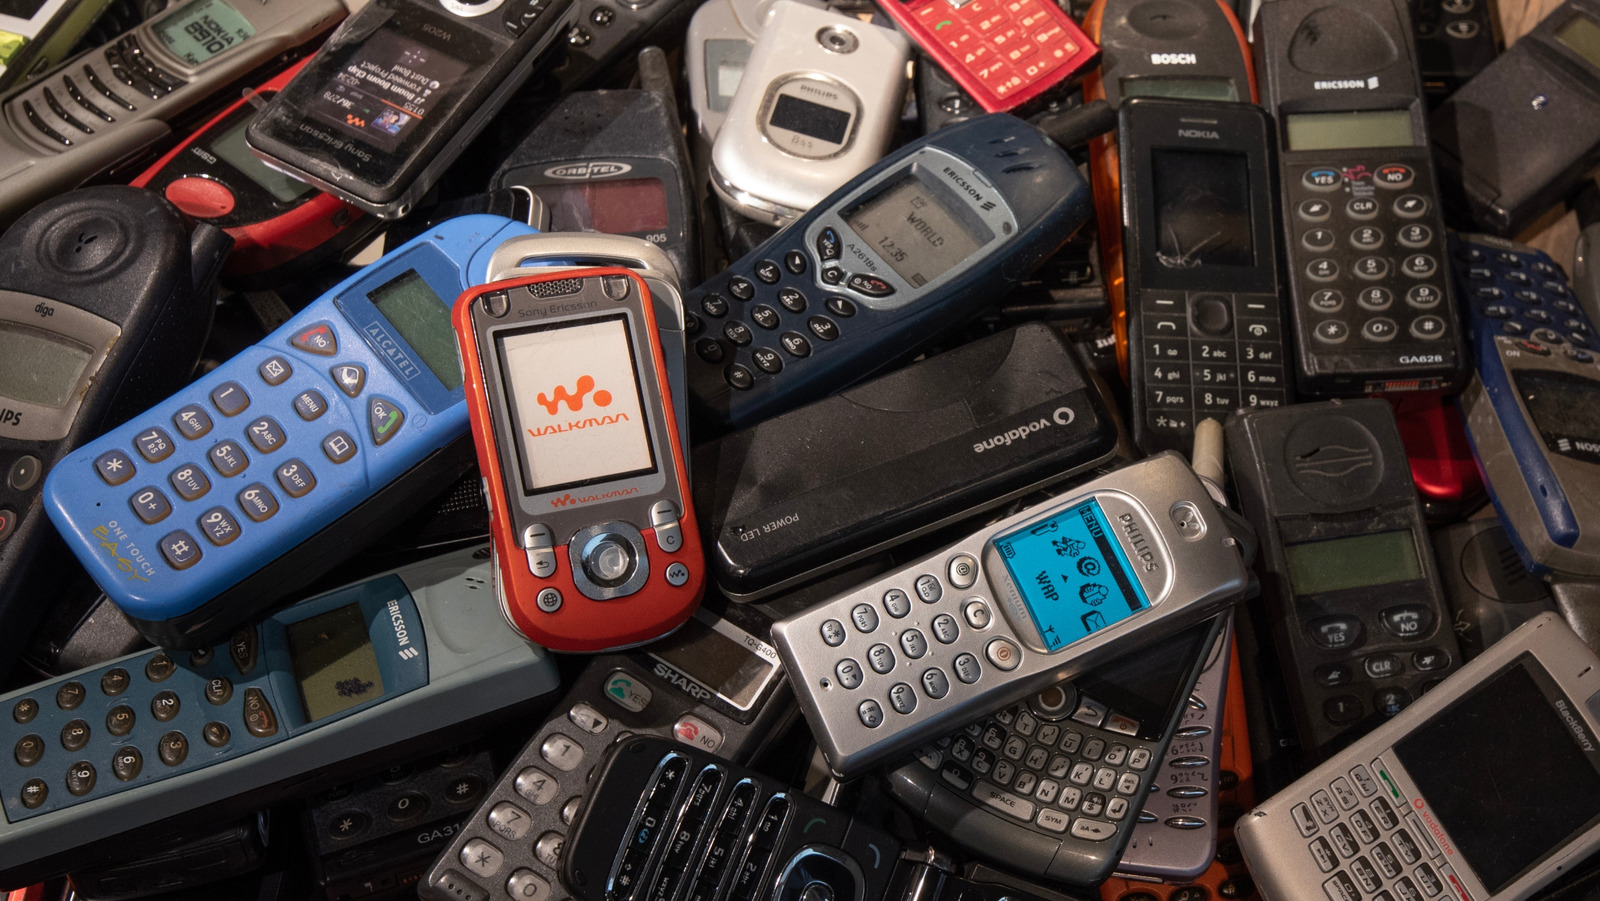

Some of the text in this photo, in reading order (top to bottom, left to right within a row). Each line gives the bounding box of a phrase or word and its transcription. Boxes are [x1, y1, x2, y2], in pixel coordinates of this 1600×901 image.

[202, 14, 234, 45] NOKIA
[184, 21, 225, 54] 8910
[1151, 53, 1196, 65] BOSCH
[348, 65, 366, 80] Clap
[361, 60, 388, 78] Project
[366, 73, 392, 92] Boom
[410, 72, 429, 86] Dust
[1314, 80, 1364, 90] ERICSSON
[390, 82, 414, 101] Boom
[801, 84, 838, 100] PHILIPS
[1178, 128, 1220, 140] NOKIA
[300, 124, 372, 162] Sony Ericsson
[191, 146, 216, 165] GSM
[555, 164, 619, 176] ORBITEL
[943, 166, 984, 202] ERICSSON
[1314, 176, 1334, 184] YES
[1388, 173, 1402, 182] NO
[1354, 202, 1373, 210] CLR
[906, 211, 944, 248] WORLD
[1362, 230, 1372, 238] 2
[1410, 227, 1420, 236] 3
[646, 234, 667, 244] 905
[877, 235, 909, 264] 12:35
[846, 243, 878, 273] A2618s
[1367, 259, 1376, 268] 5
[1414, 258, 1424, 266] 6
[1318, 261, 1328, 270] 4
[827, 269, 838, 280] C
[862, 280, 872, 290] NO
[1323, 292, 1332, 300] 7
[1371, 290, 1381, 299] 8
[1419, 288, 1429, 296] 9
[518, 300, 598, 318] Sony Ericsson
[314, 335, 328, 348] NO
[369, 326, 414, 376] ALCATEL
[1202, 346, 1227, 358] 2 abc
[1246, 348, 1272, 360] 3 def
[1400, 355, 1443, 364] GA628
[1154, 367, 1162, 378] 4
[1204, 369, 1211, 381] 5
[1248, 370, 1276, 384] 6 mno
[220, 387, 234, 398] 1
[1154, 391, 1184, 404] 7 pqrs
[1204, 393, 1229, 405] 8 tuv
[300, 394, 319, 412] MENU
[1250, 394, 1258, 406] 9
[374, 406, 386, 420] OK
[181, 410, 202, 432] 4 GHI
[528, 412, 630, 438] WALKMAN
[142, 431, 167, 450] 7 PQ
[252, 422, 276, 446] 2 ABC
[973, 418, 1051, 454] vodafone
[146, 443, 158, 454] RS
[216, 445, 238, 468] 5 JKL
[177, 469, 200, 492] 8 TUV
[283, 464, 306, 488] 3 DEF
[244, 488, 268, 514] 6 MNO
[577, 487, 639, 504] WALKMAN
[206, 512, 233, 534] 9 WX
[740, 512, 799, 544] POWER LED
[1080, 506, 1104, 538] MENU
[212, 524, 224, 538] YZ
[666, 535, 676, 546] C
[1118, 512, 1159, 574] PHILIPS
[92, 524, 150, 584] EASY
[108, 520, 156, 576] ONE TOUCH
[1034, 570, 1060, 602] WAP
[888, 593, 900, 602] 4
[857, 607, 868, 616] 7
[973, 608, 984, 618] C
[386, 600, 410, 647] ERICSSON
[938, 618, 948, 628] 2
[1401, 622, 1418, 632] NO
[906, 634, 918, 643] 5
[1327, 632, 1346, 643] YES
[236, 642, 248, 660] YES
[743, 634, 778, 660] TQ-G400
[873, 648, 884, 658] 8
[958, 658, 970, 667] 3
[1372, 661, 1391, 672] CLR
[652, 662, 712, 701] SHARP
[925, 672, 938, 682] 6
[211, 678, 223, 696] CLR
[892, 686, 904, 696] 9
[162, 698, 174, 706] 2
[248, 694, 260, 710] NO
[628, 689, 647, 706] YES
[116, 712, 128, 722] 5
[1554, 699, 1596, 752] BlackBerry
[700, 735, 716, 749] NO
[123, 756, 135, 764] 6
[78, 770, 90, 780] 9
[532, 778, 548, 790] 4
[990, 790, 1016, 808] SPACE
[508, 811, 522, 824] 7
[1045, 814, 1062, 827] SYM
[1422, 811, 1455, 856] vodafone
